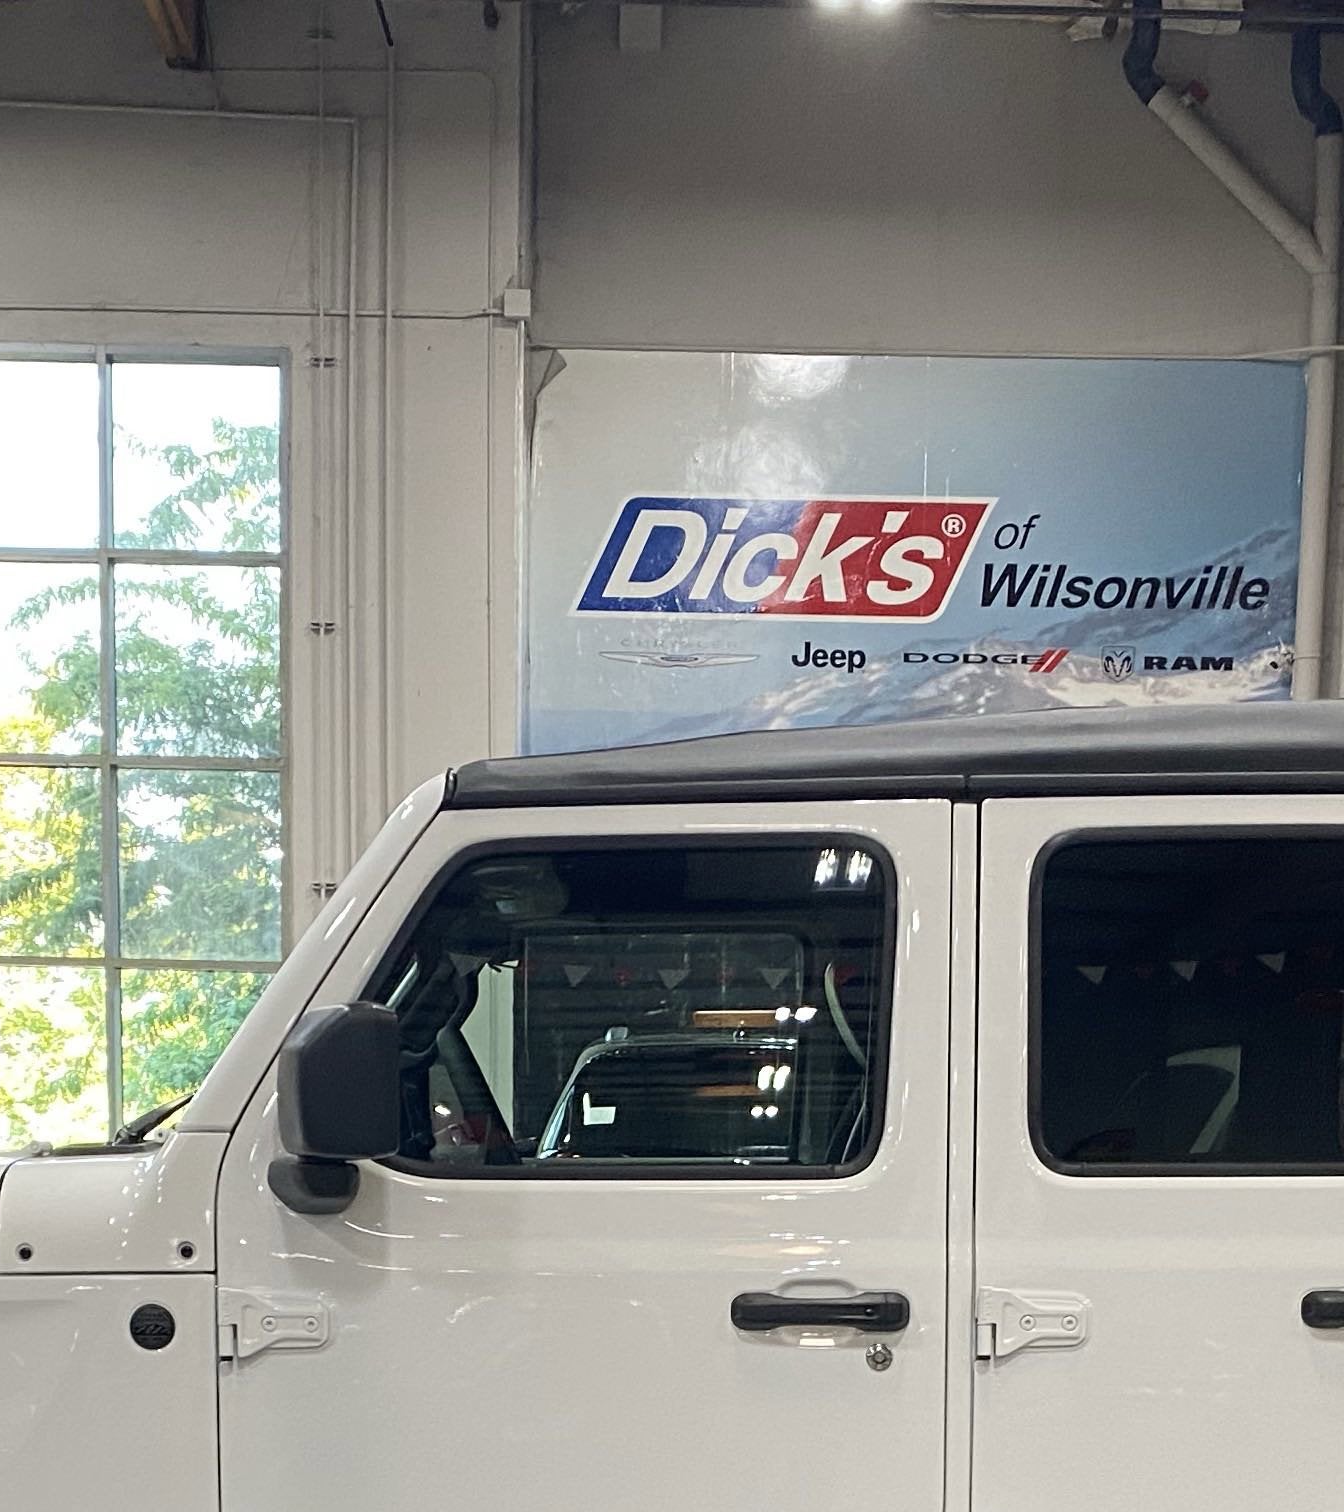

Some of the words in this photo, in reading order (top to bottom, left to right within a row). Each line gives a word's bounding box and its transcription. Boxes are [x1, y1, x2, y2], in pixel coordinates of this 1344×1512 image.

[994, 514, 1041, 550] of
[980, 563, 1271, 611] Wilsonville
[791, 641, 866, 673] Jeep
[903, 652, 1044, 665] DODGE
[1144, 655, 1234, 671] RAM
